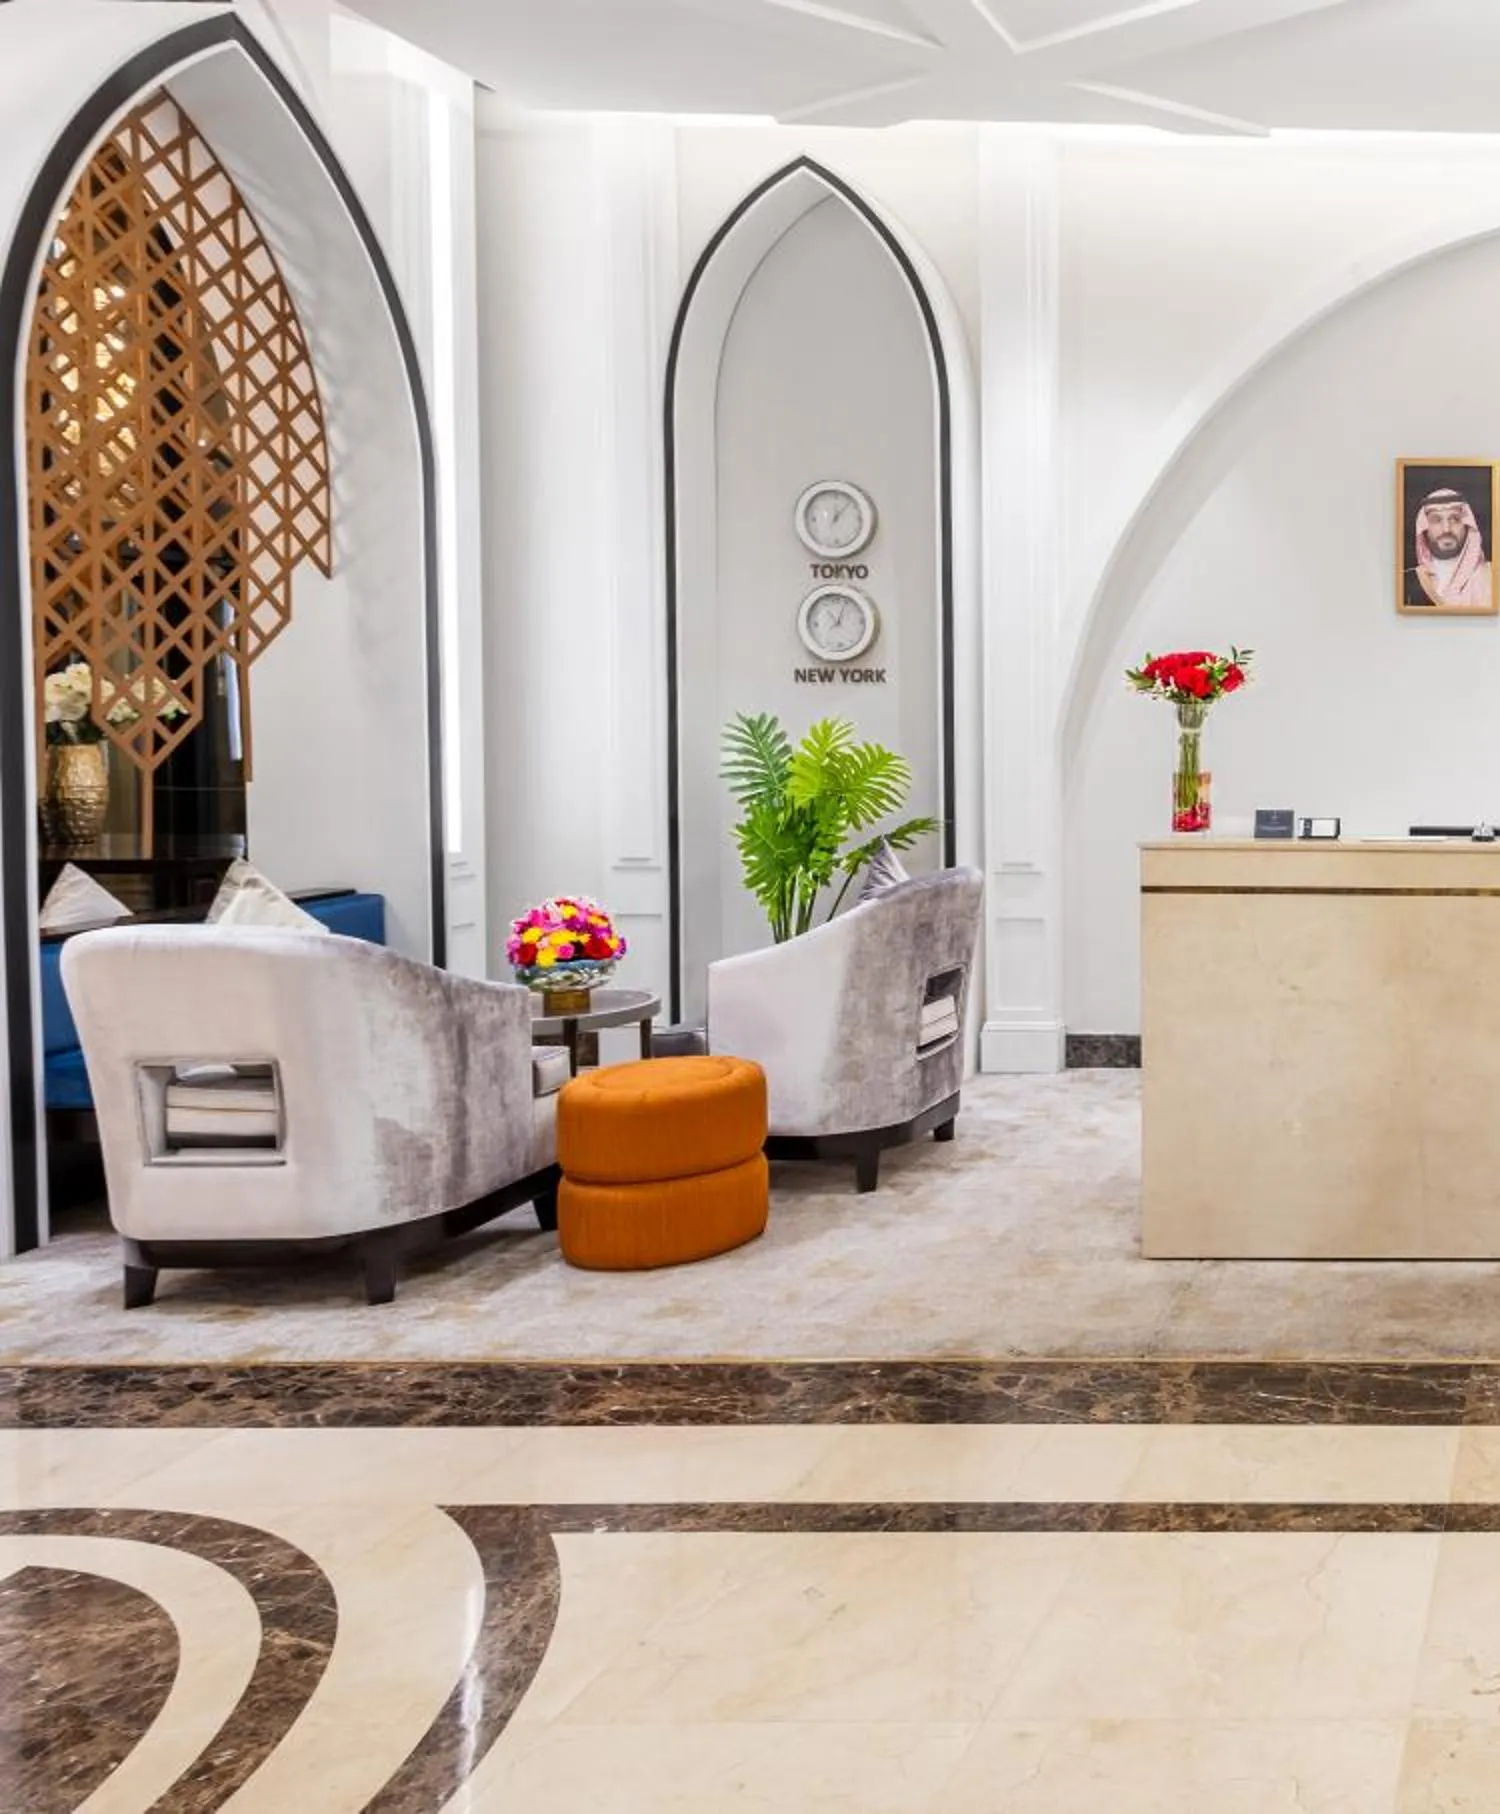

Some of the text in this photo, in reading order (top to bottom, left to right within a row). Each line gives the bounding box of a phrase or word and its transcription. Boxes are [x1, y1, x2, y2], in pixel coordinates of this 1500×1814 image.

[810, 563, 869, 580] TOKYO
[794, 668, 887, 684] NEW YORK
